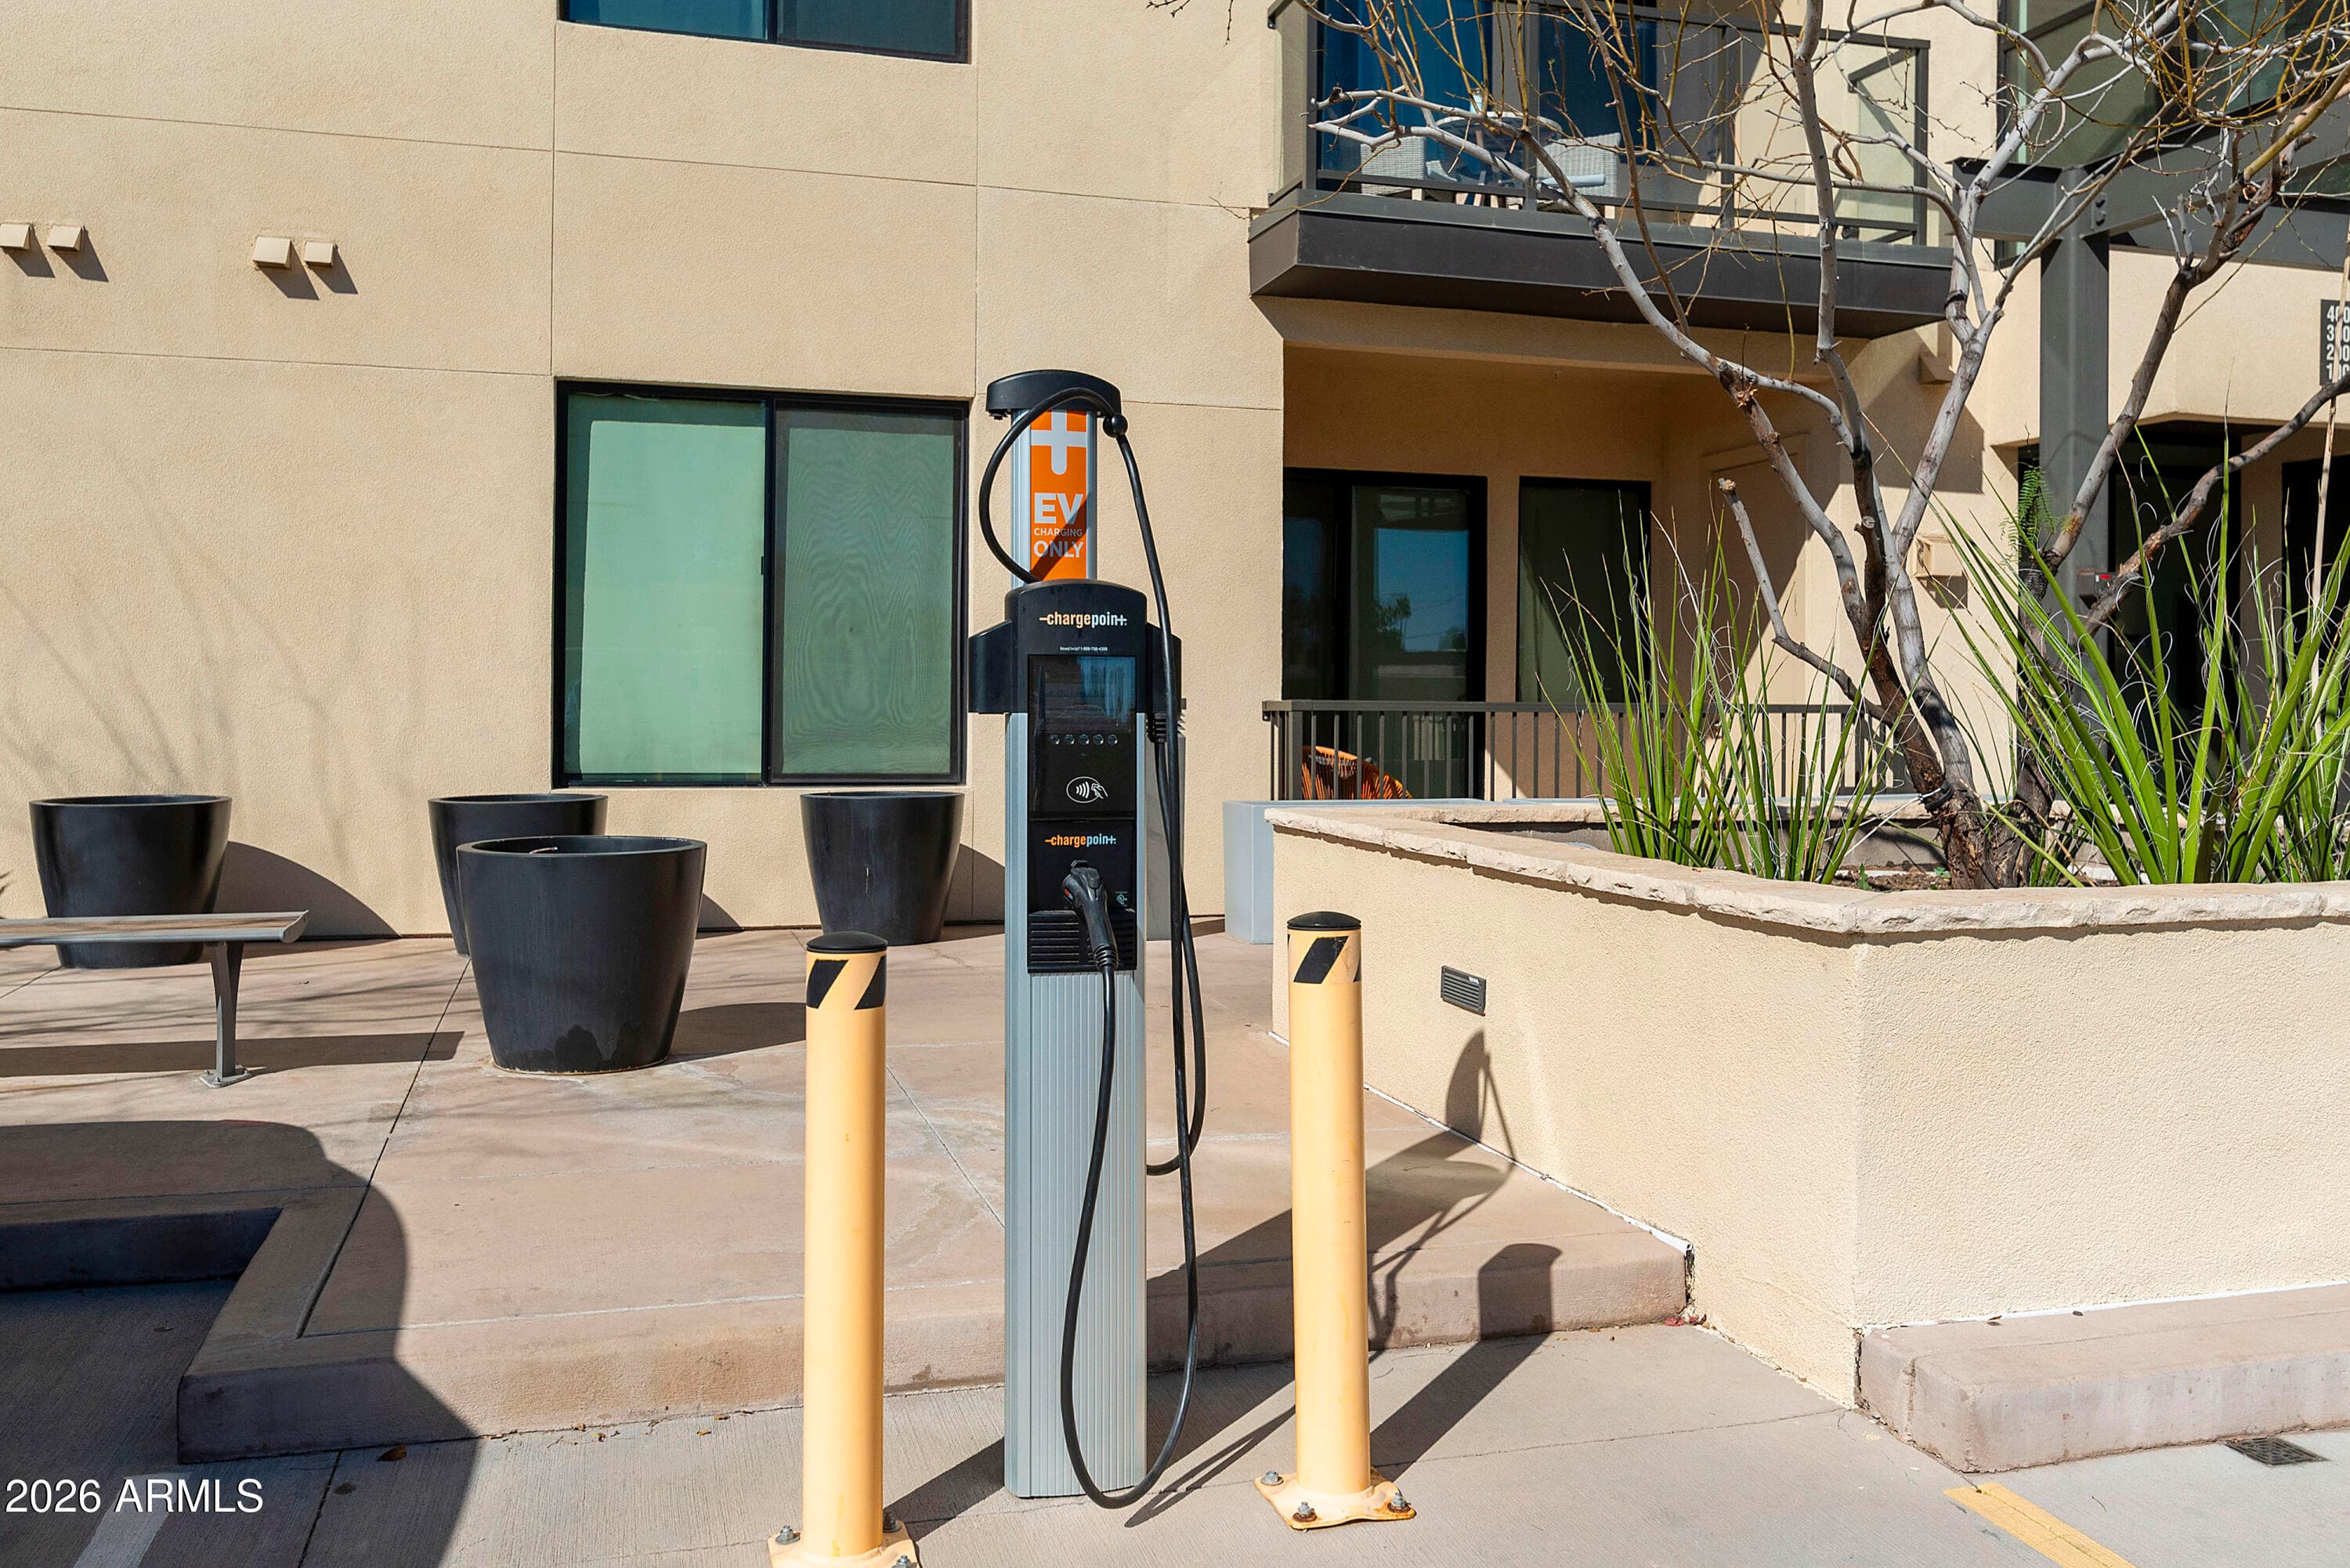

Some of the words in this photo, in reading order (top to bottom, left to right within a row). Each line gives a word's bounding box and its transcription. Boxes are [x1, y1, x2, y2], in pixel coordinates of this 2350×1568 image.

[2326, 323, 2350, 342] 30
[2326, 343, 2350, 361] 20
[1034, 492, 1083, 525] EV
[1034, 527, 1083, 537] CHARGING
[1033, 540, 1083, 558] ONLY
